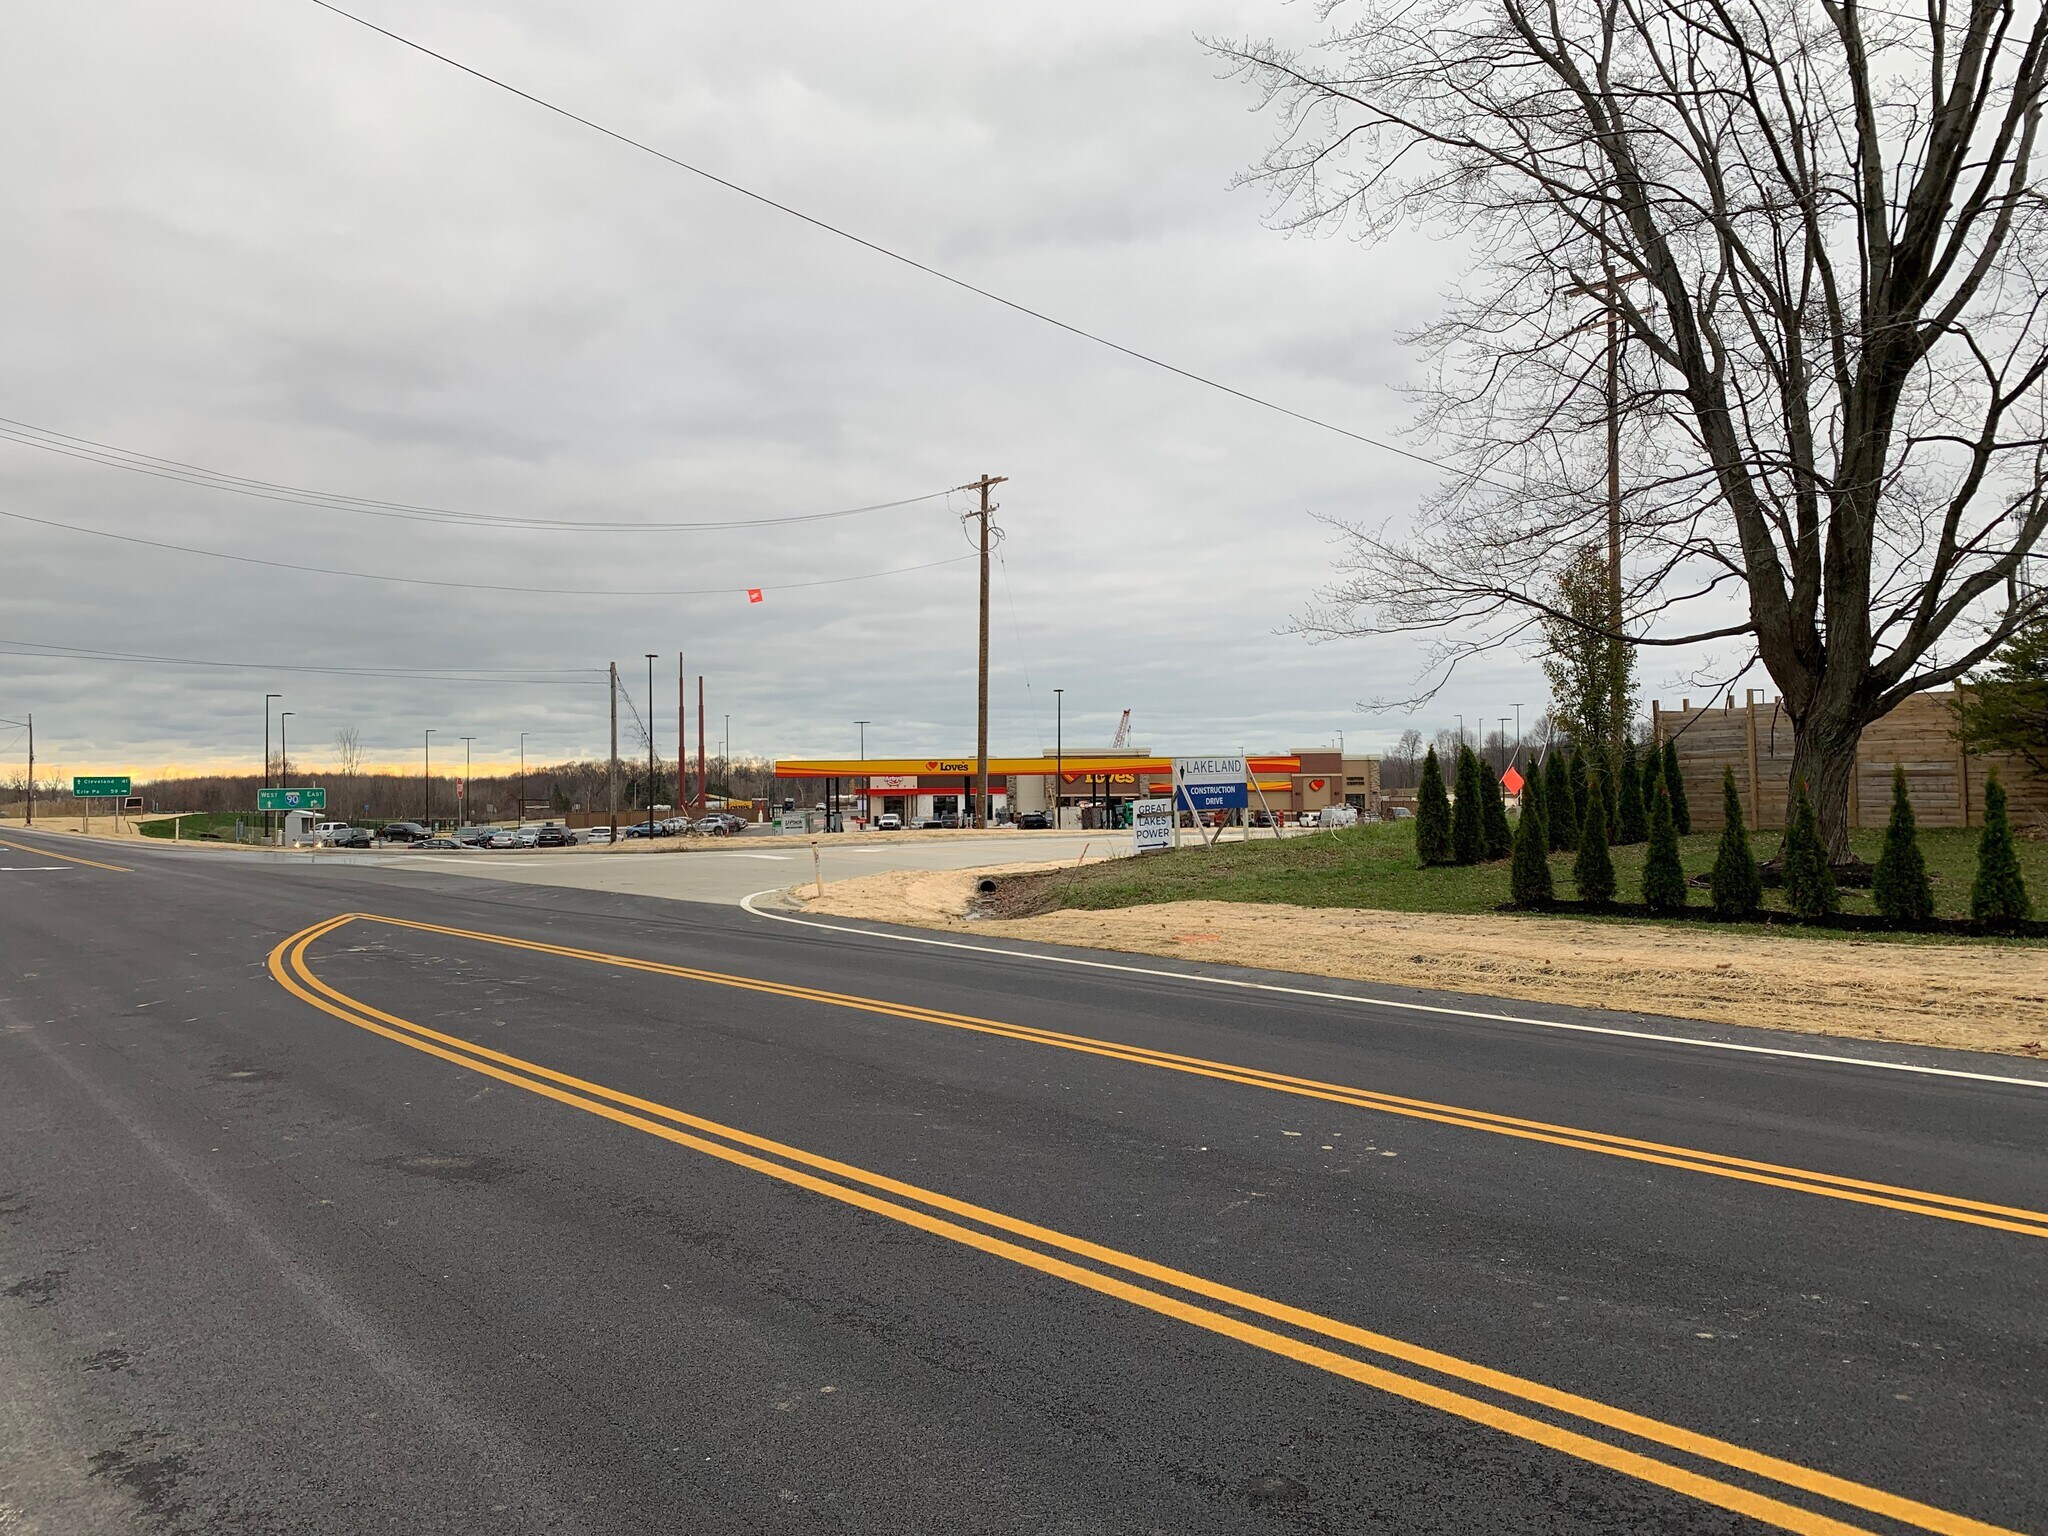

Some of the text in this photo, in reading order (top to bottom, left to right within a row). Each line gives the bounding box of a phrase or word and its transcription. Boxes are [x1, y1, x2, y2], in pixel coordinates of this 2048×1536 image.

[1186, 760, 1241, 773] LAKELAND
[1190, 786, 1235, 795] CONSTRUCTION
[286, 795, 299, 804] 90
[1205, 797, 1223, 805] DRIVE
[1138, 803, 1166, 814] GREAT
[1139, 815, 1166, 826] LAKES
[1136, 828, 1169, 839] POWER
